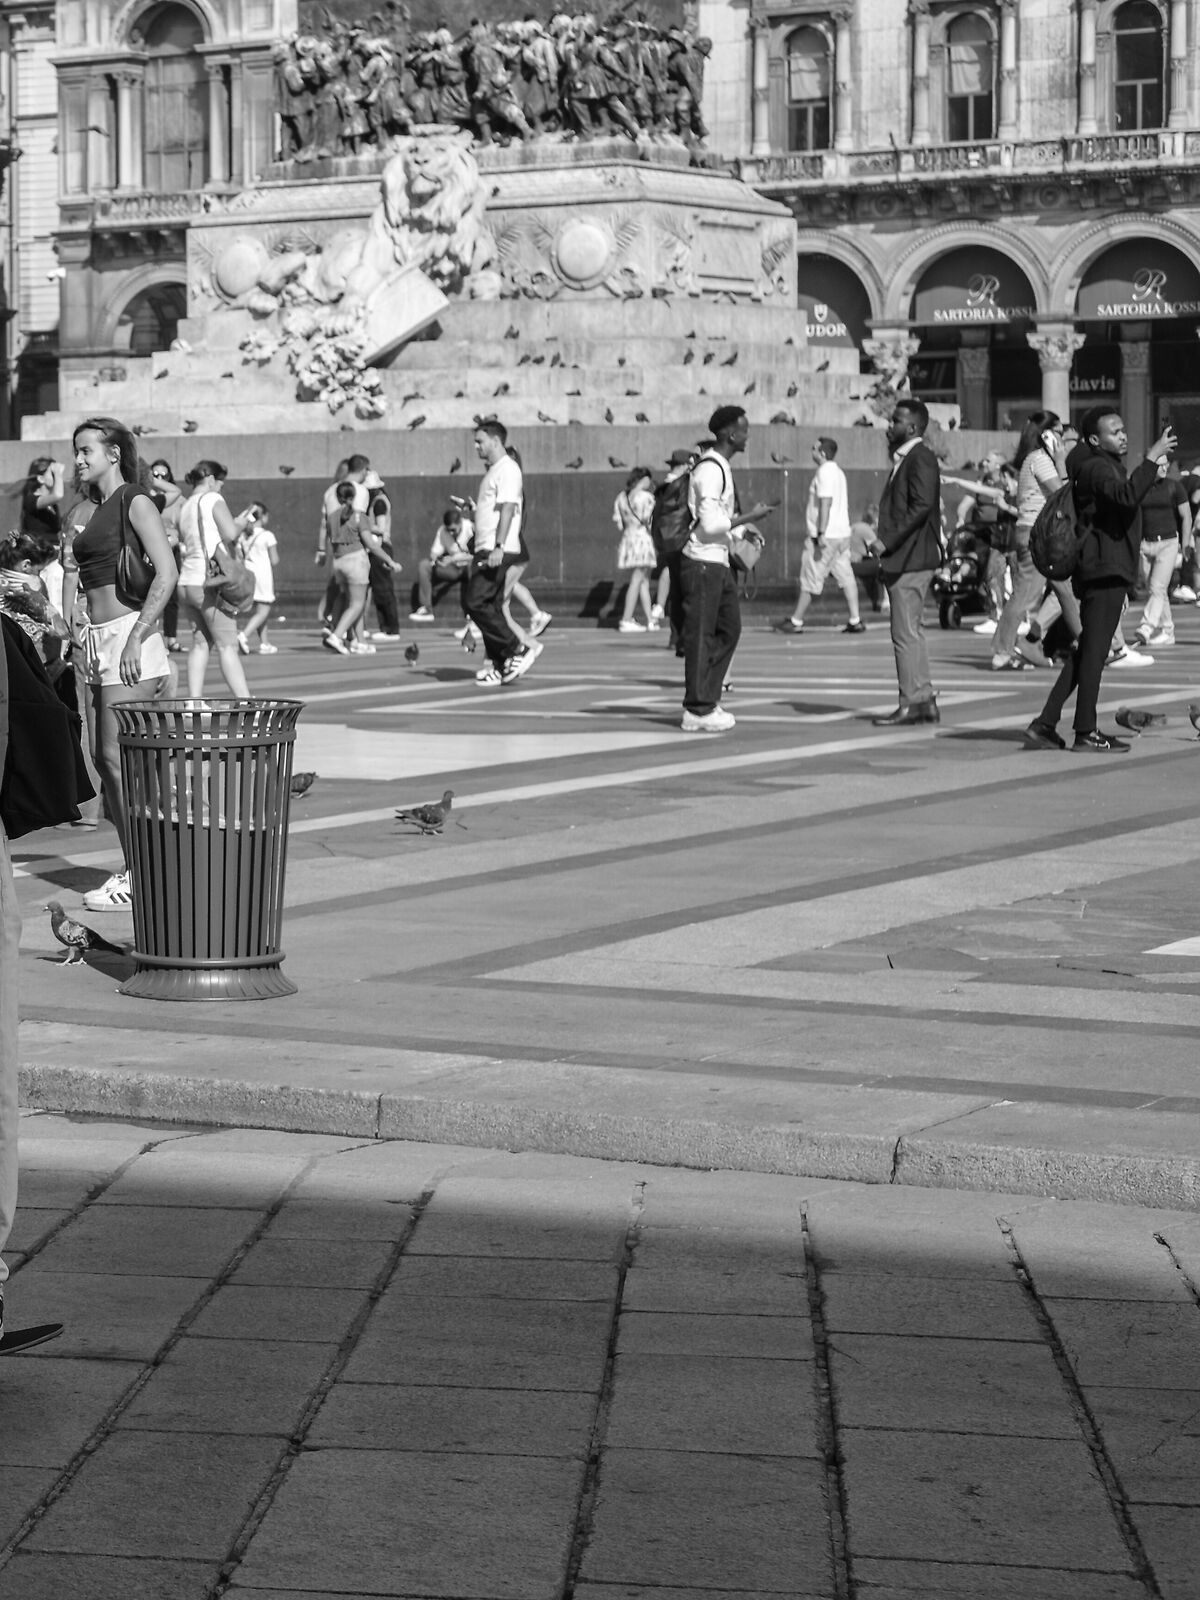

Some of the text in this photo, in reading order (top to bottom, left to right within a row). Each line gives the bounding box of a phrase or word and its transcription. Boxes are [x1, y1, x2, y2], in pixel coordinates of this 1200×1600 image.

[934, 307, 995, 322] SARTORIA
[1097, 300, 1200, 316] SARTORIA ROSSI
[805, 322, 846, 337] UDOR
[1069, 375, 1116, 392] davis
